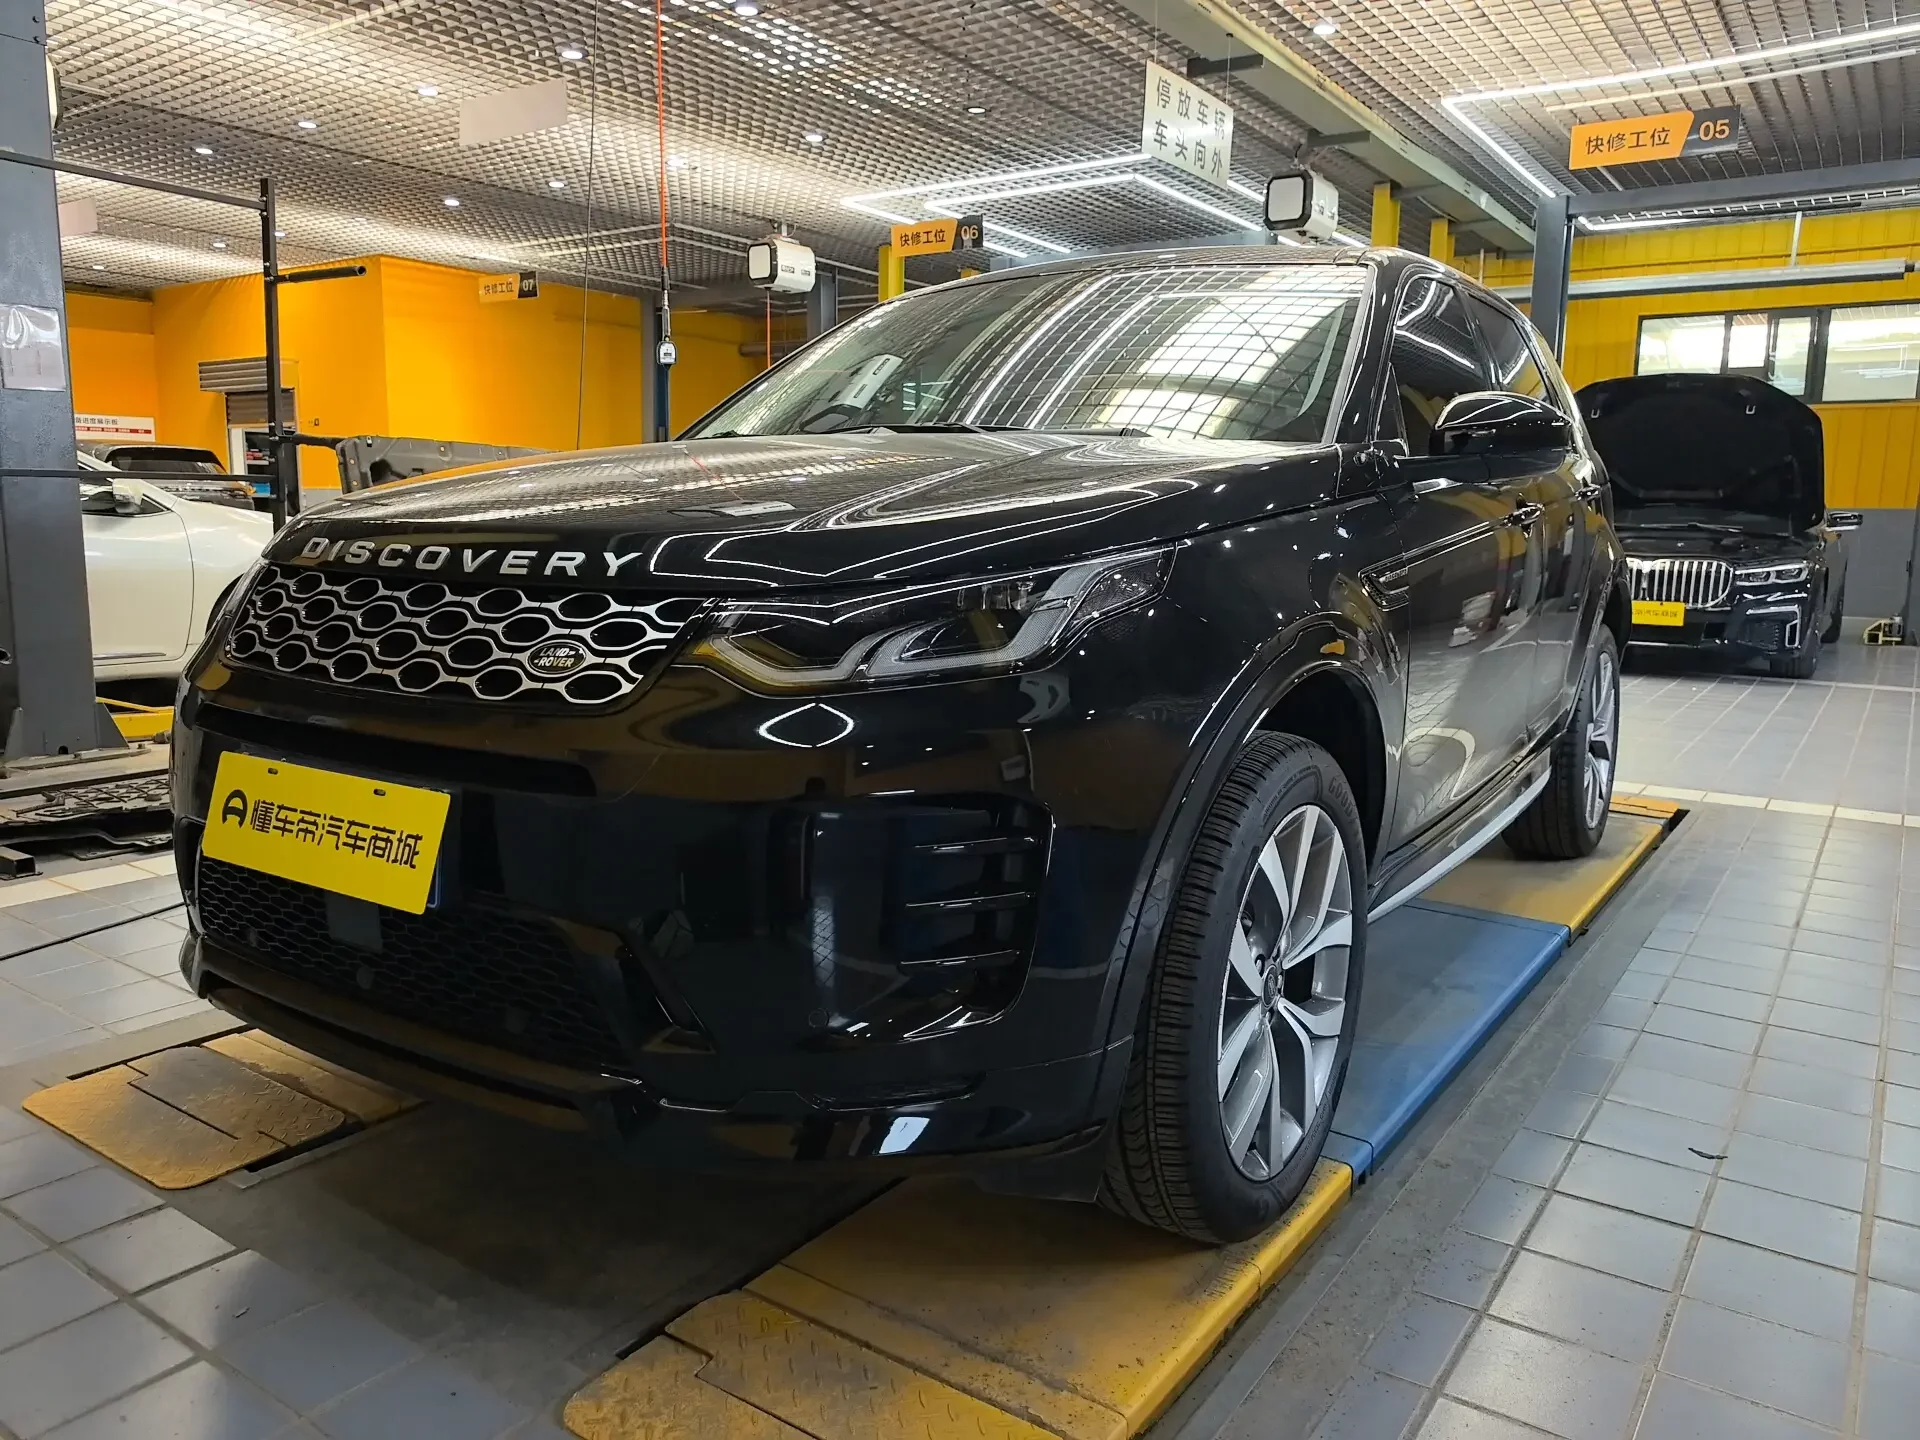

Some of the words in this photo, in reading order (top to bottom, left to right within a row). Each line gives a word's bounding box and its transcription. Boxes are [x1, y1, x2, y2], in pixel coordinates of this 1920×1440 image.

[1156, 76, 1226, 140] 停放车辆
[1153, 118, 1223, 178] 车头向外
[1585, 127, 1671, 155] 快修工位
[1699, 119, 1730, 141] 05
[900, 228, 946, 247] 快修工位
[961, 225, 979, 240] 06
[484, 281, 514, 295] 快修工位
[522, 279, 534, 291] 07
[300, 537, 643, 577] DISCOVERY
[538, 656, 575, 667] ROVER
[540, 647, 570, 657] LAND
[250, 798, 424, 870] 懂车帝汽车商城
